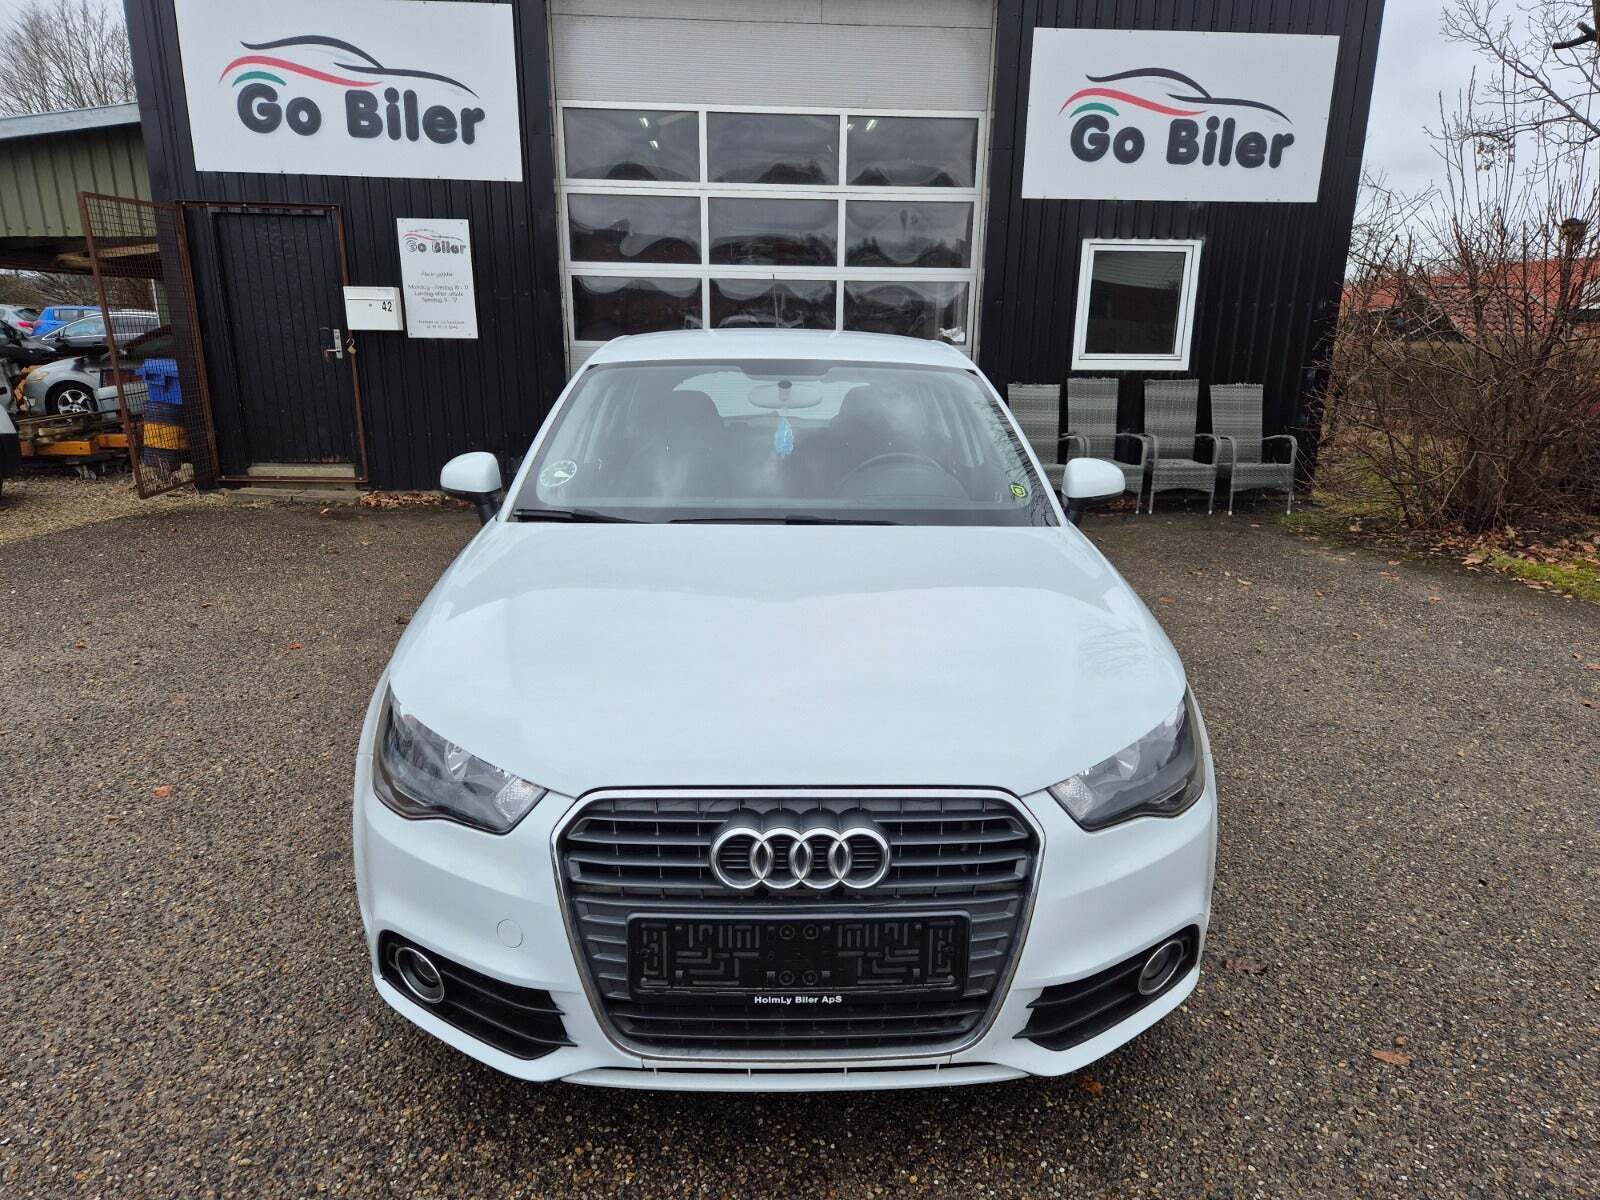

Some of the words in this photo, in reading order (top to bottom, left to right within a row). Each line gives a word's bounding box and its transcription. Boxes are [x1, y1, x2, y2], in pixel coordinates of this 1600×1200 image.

[237, 83, 322, 136] Go
[345, 87, 485, 145] Biler
[1070, 114, 1145, 163] Go
[1166, 116, 1294, 168] Biler
[382, 301, 392, 312] 42
[754, 996, 792, 1005] HolmLy
[795, 996, 818, 1004] Biler
[822, 995, 842, 1004] ApS
